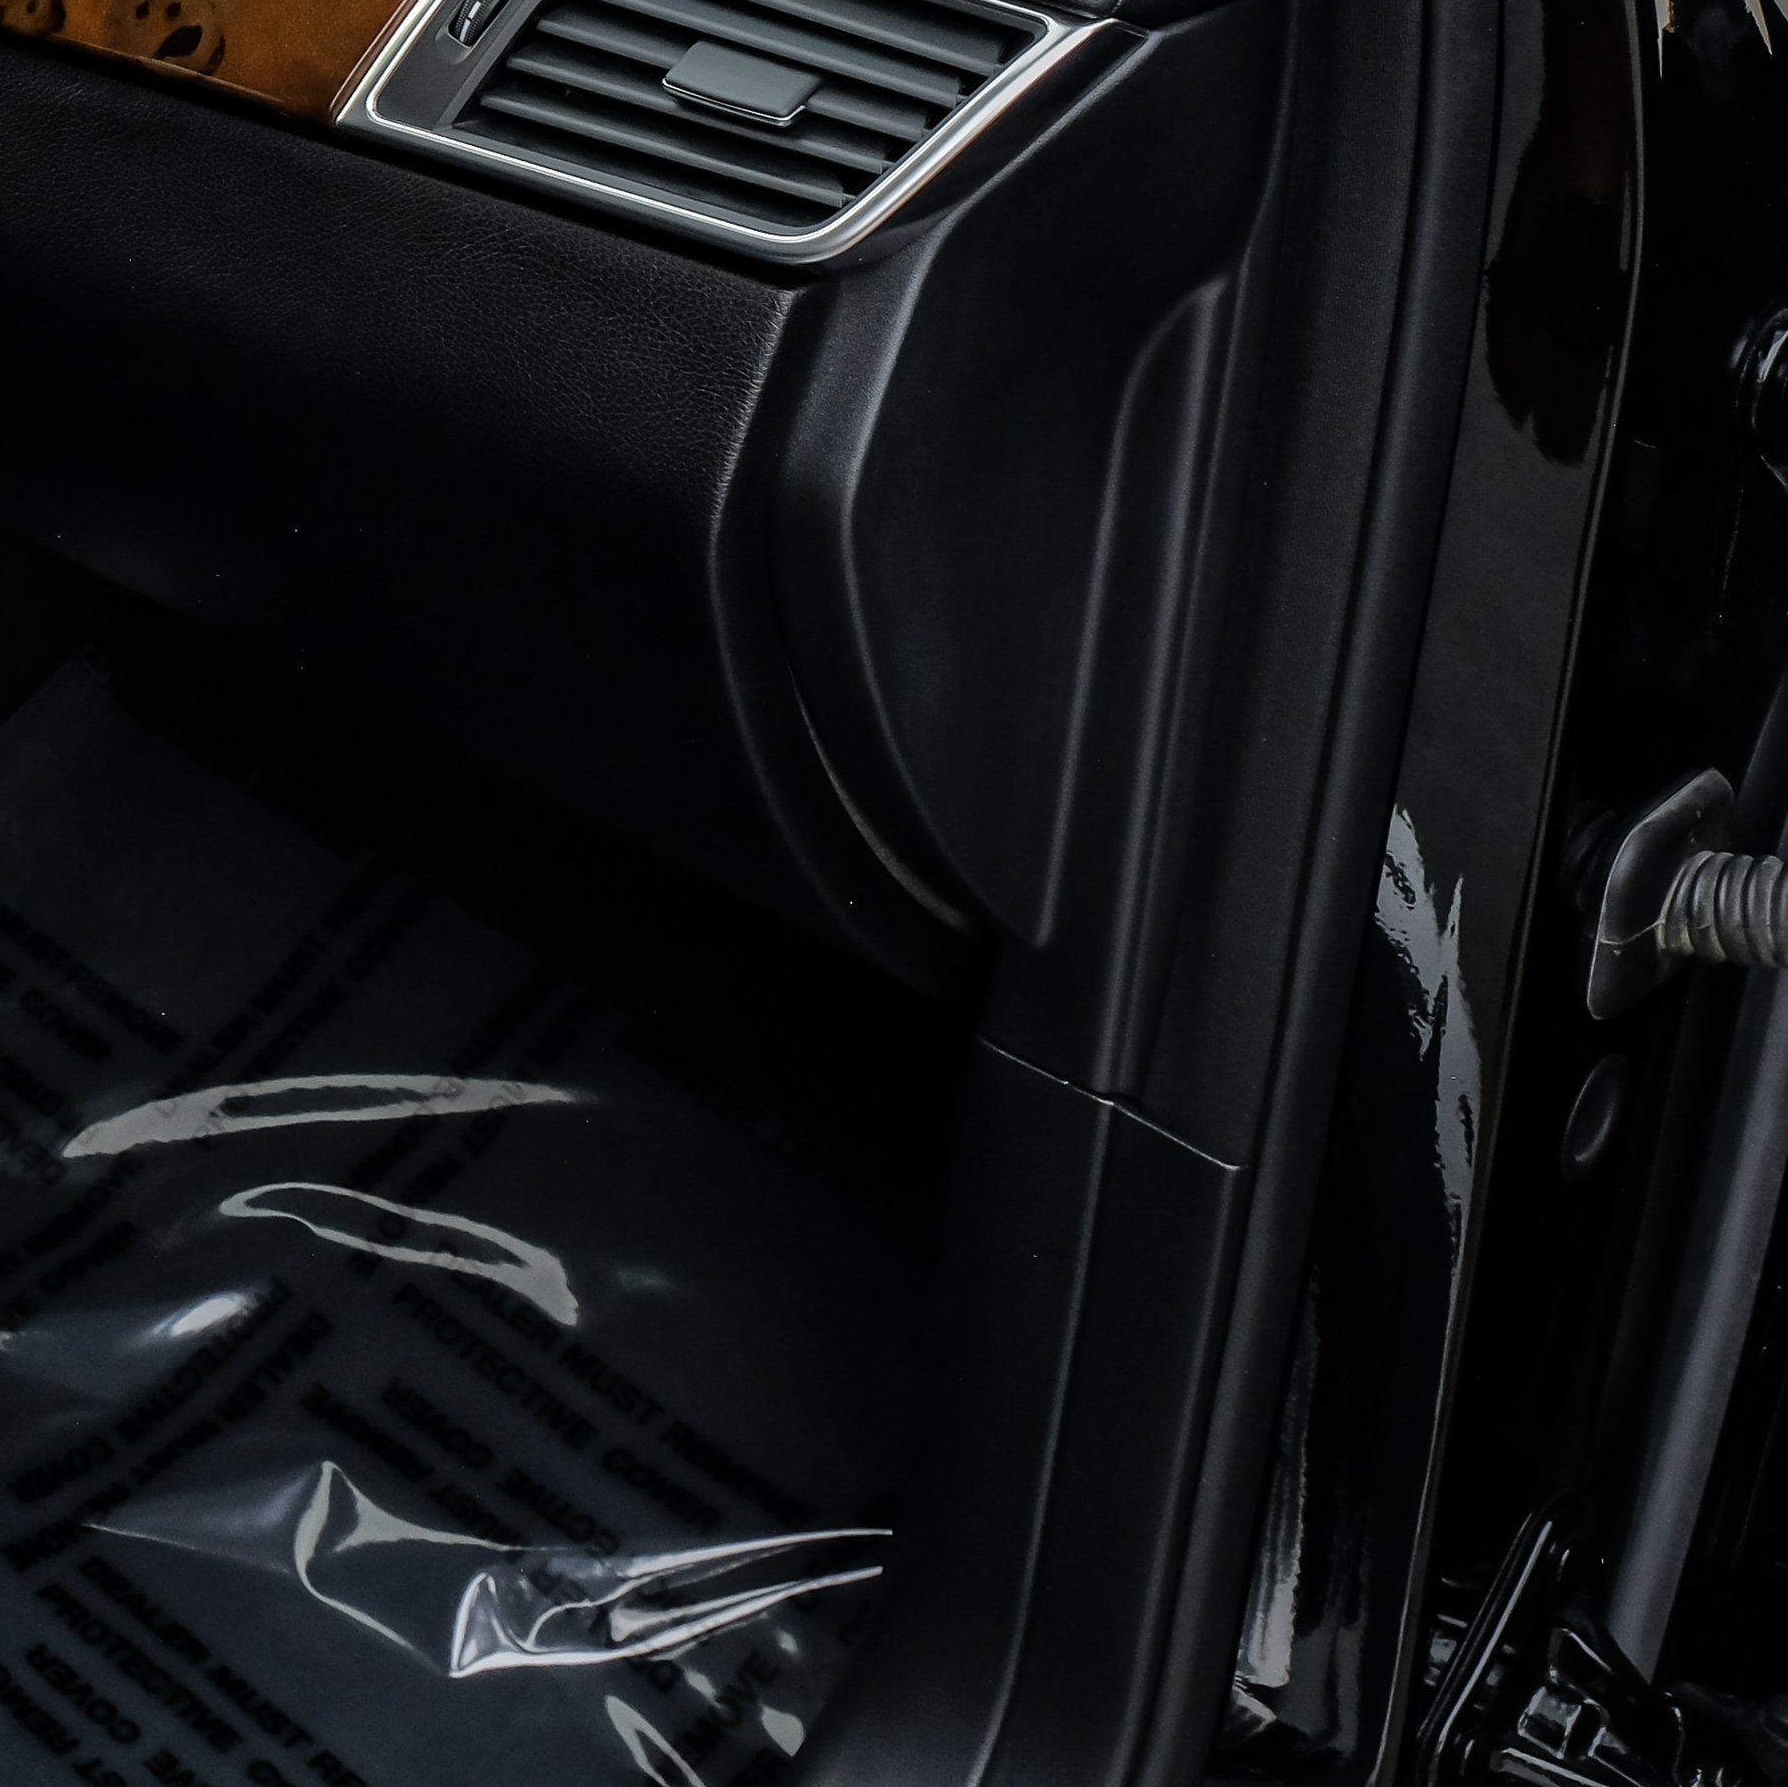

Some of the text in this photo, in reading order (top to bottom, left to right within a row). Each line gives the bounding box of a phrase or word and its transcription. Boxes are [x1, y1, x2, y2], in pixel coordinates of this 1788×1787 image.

[216, 1312, 333, 1426] DEALER
[391, 1280, 599, 1448] PROTECTIVE
[558, 1338, 666, 1429] MUST
[6, 1436, 116, 1509] COVER
[379, 1377, 494, 1473] COVER
[25, 1643, 138, 1744] COVER
[37, 1582, 242, 1754] PROTECTIVE
[79, 1554, 312, 1750] DEALER MUST
